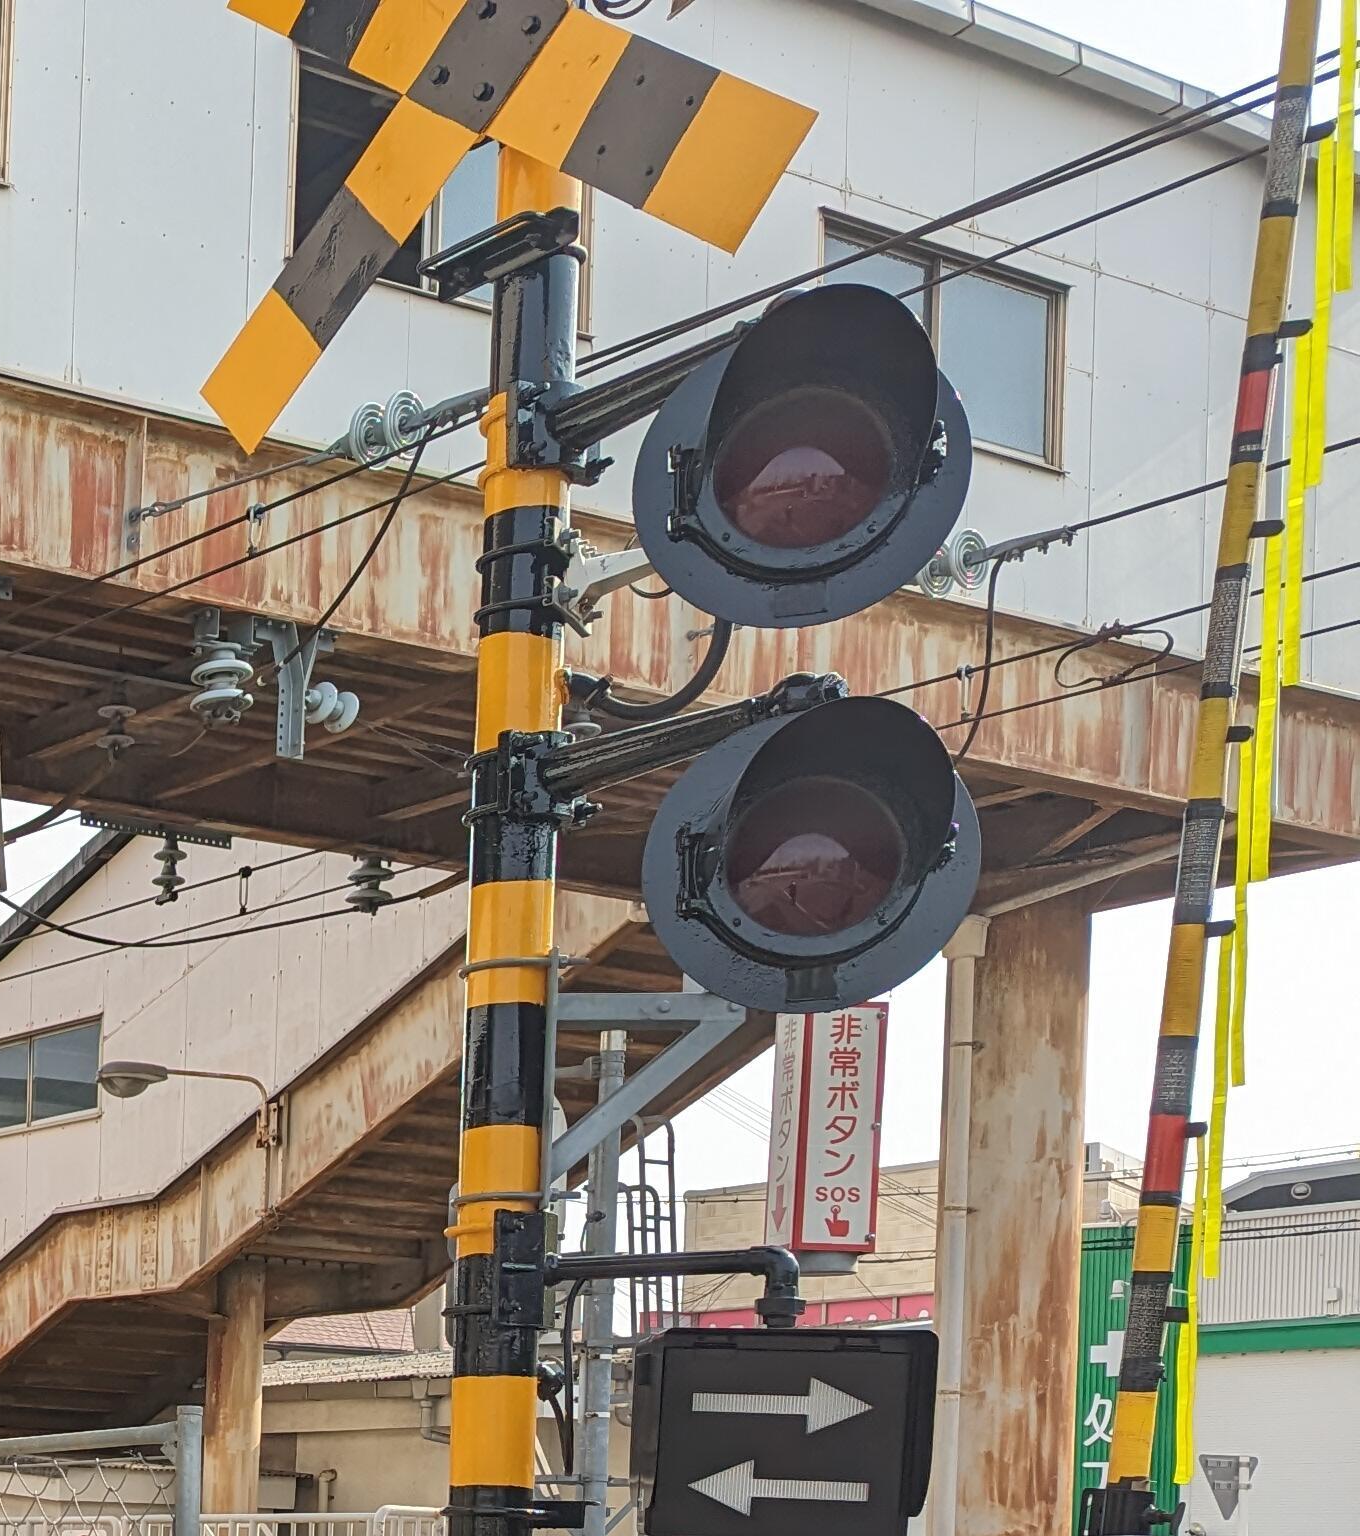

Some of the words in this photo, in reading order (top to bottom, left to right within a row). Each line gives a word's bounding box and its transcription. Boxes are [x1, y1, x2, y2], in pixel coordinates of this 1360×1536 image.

[775, 1017, 798, 1184] 非常ボタン
[823, 1013, 862, 1178] 非常ボタン
[815, 1185, 861, 1203] SOS
